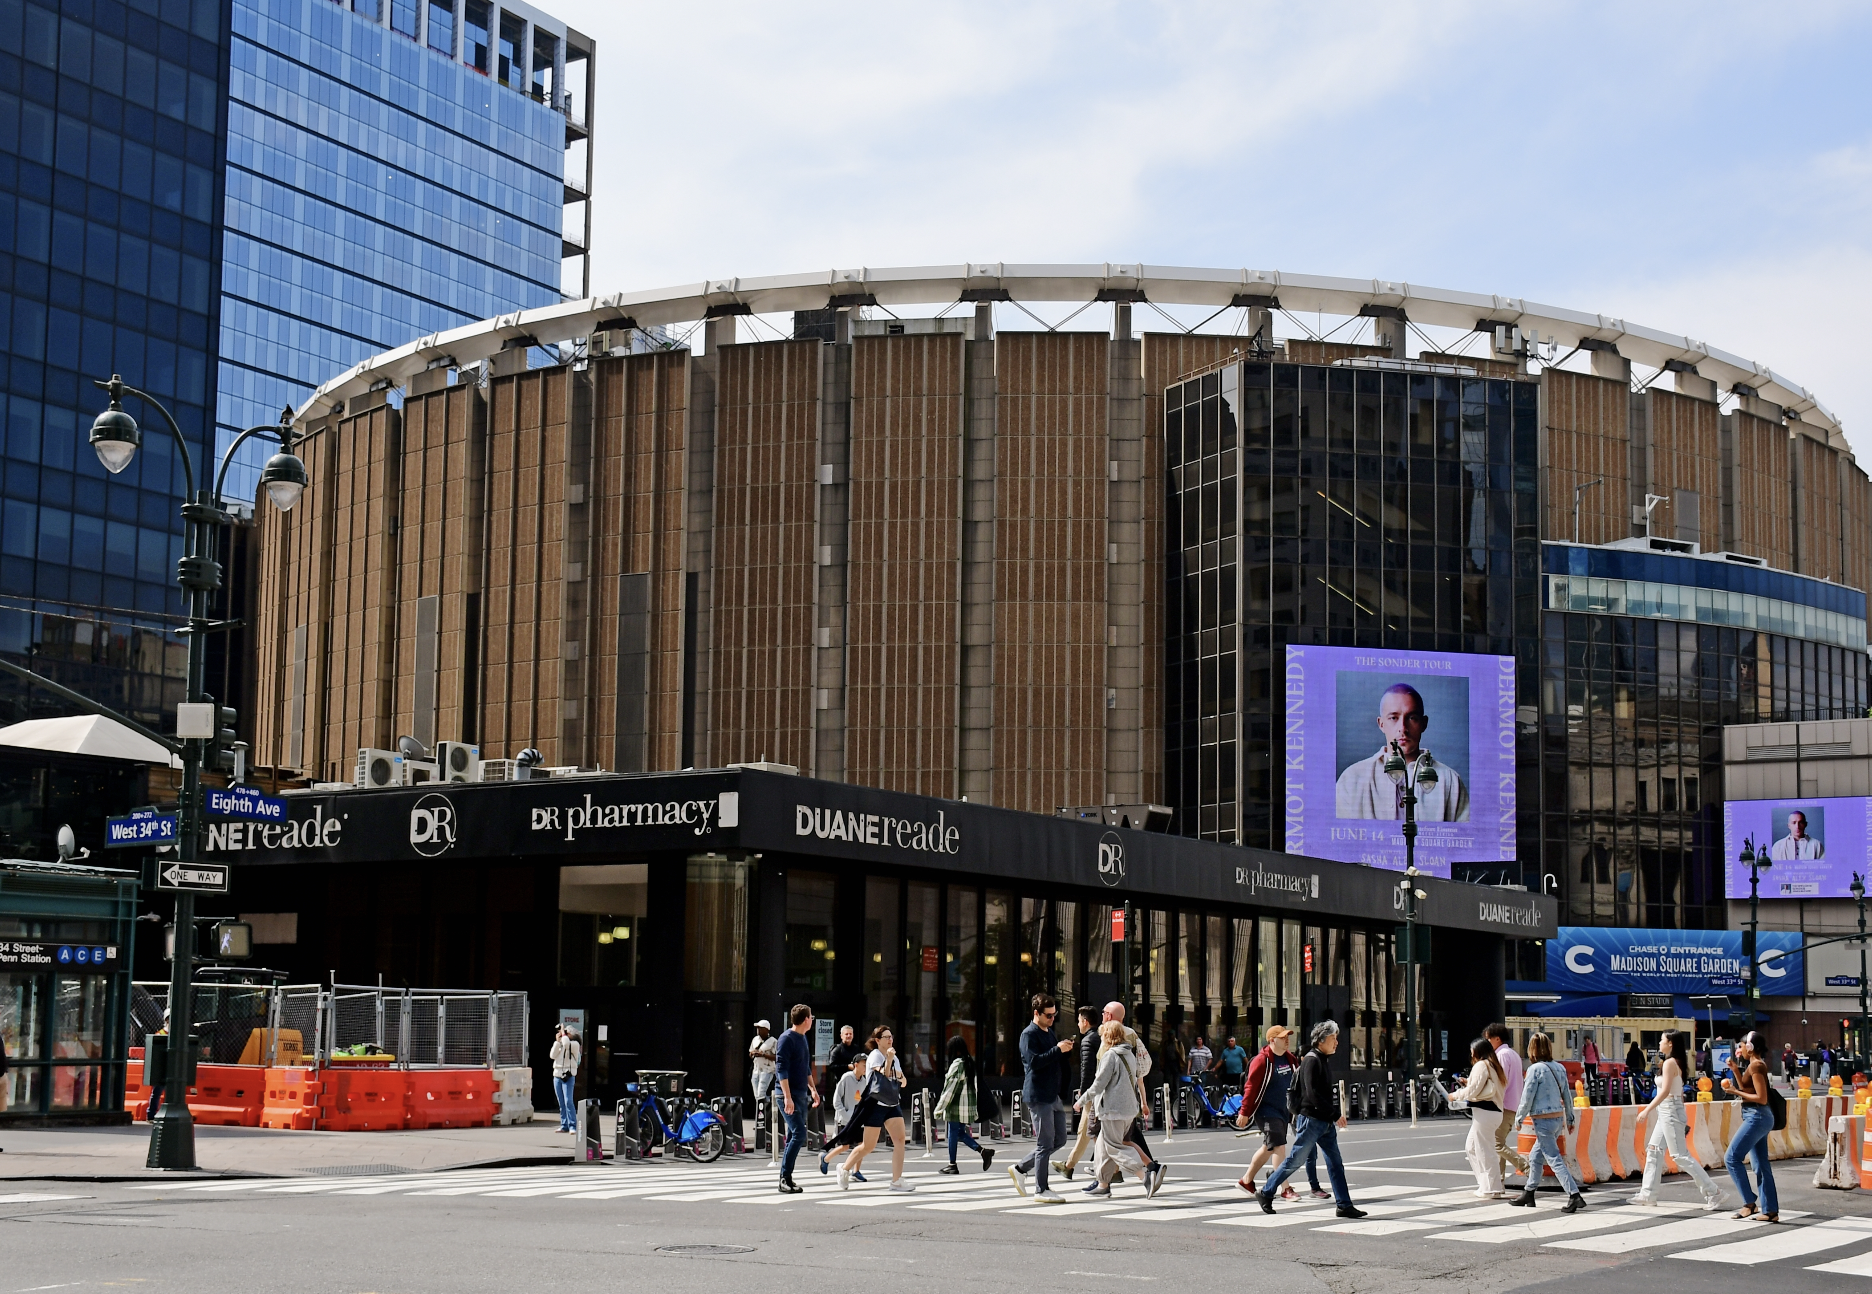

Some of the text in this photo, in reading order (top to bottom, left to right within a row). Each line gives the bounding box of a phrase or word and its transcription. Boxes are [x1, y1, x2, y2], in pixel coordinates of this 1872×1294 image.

[1355, 656, 1452, 670] THE SONDER TOUR
[1286, 644, 1304, 771] KENNEDY
[1499, 656, 1516, 765] DERMOT
[212, 793, 281, 817] Eighth Ave
[531, 793, 717, 841] DR pharmacy
[111, 820, 171, 840] West 34th St
[1331, 828, 1384, 842] JUNE 14
[1421, 838, 1445, 847] SQUARE
[1447, 839, 1473, 848] GARDEN
[1361, 853, 1387, 865] SASHA
[1419, 855, 1446, 867] SLOAN
[170, 870, 217, 883] ONE WAY
[1235, 862, 1311, 901] DR pharmacy
[0, 943, 9, 952] 34
[1629, 945, 1723, 955] CHASE ENTRANCE
[20, 953, 51, 964] Station
[61, 950, 102, 961] A C E
[1611, 954, 1657, 972] MADISON
[1660, 955, 1698, 973] SQUARE
[1701, 956, 1739, 974] GARDEN
[1647, 997, 1670, 1005] STATION
